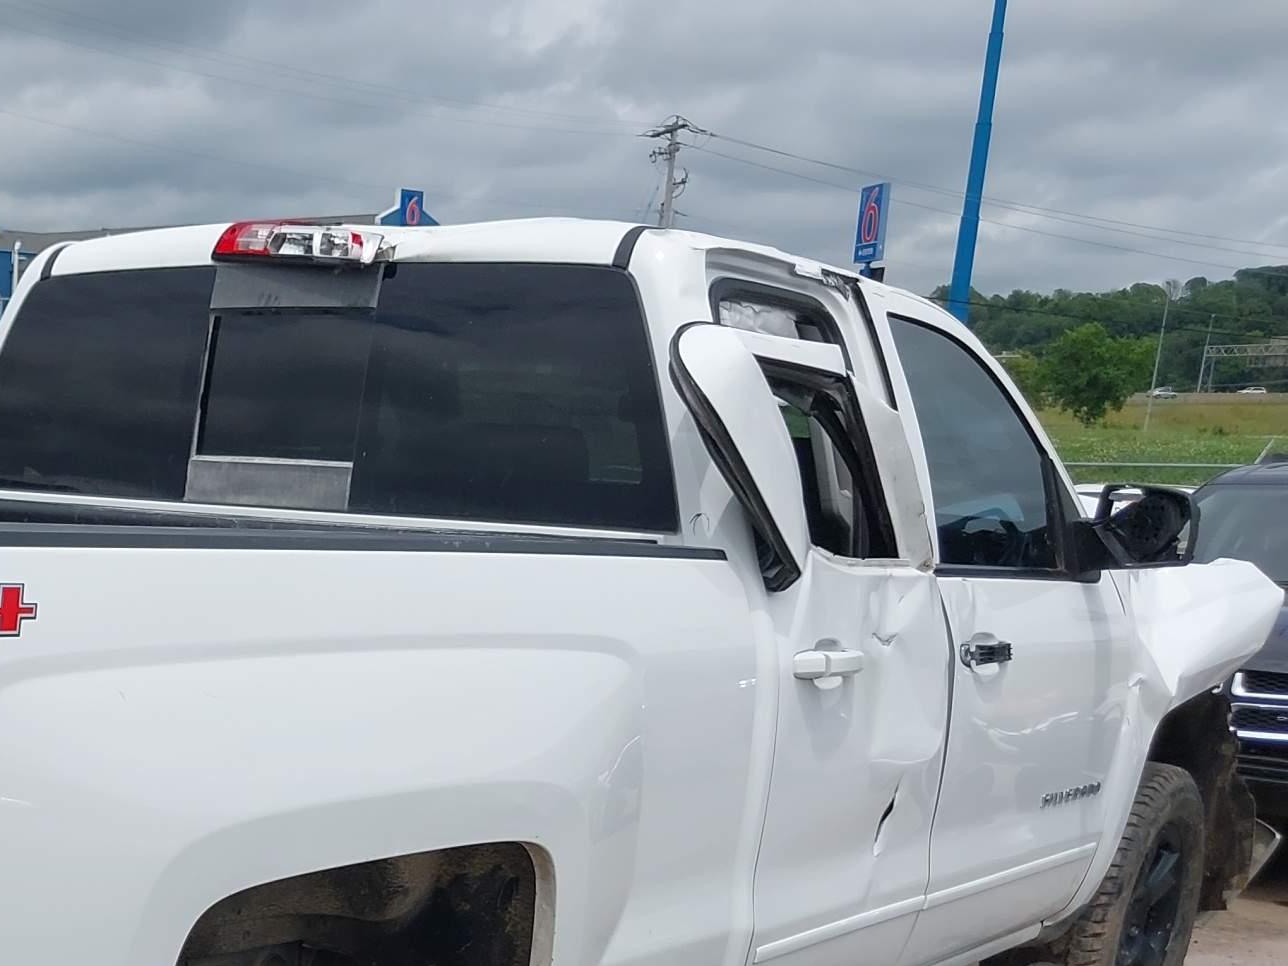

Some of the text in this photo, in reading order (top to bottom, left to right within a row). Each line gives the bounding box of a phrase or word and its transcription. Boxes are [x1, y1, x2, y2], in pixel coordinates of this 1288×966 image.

[406, 195, 421, 226] 6
[861, 186, 880, 244] 6
[1039, 781, 1102, 809] SILVERADO
